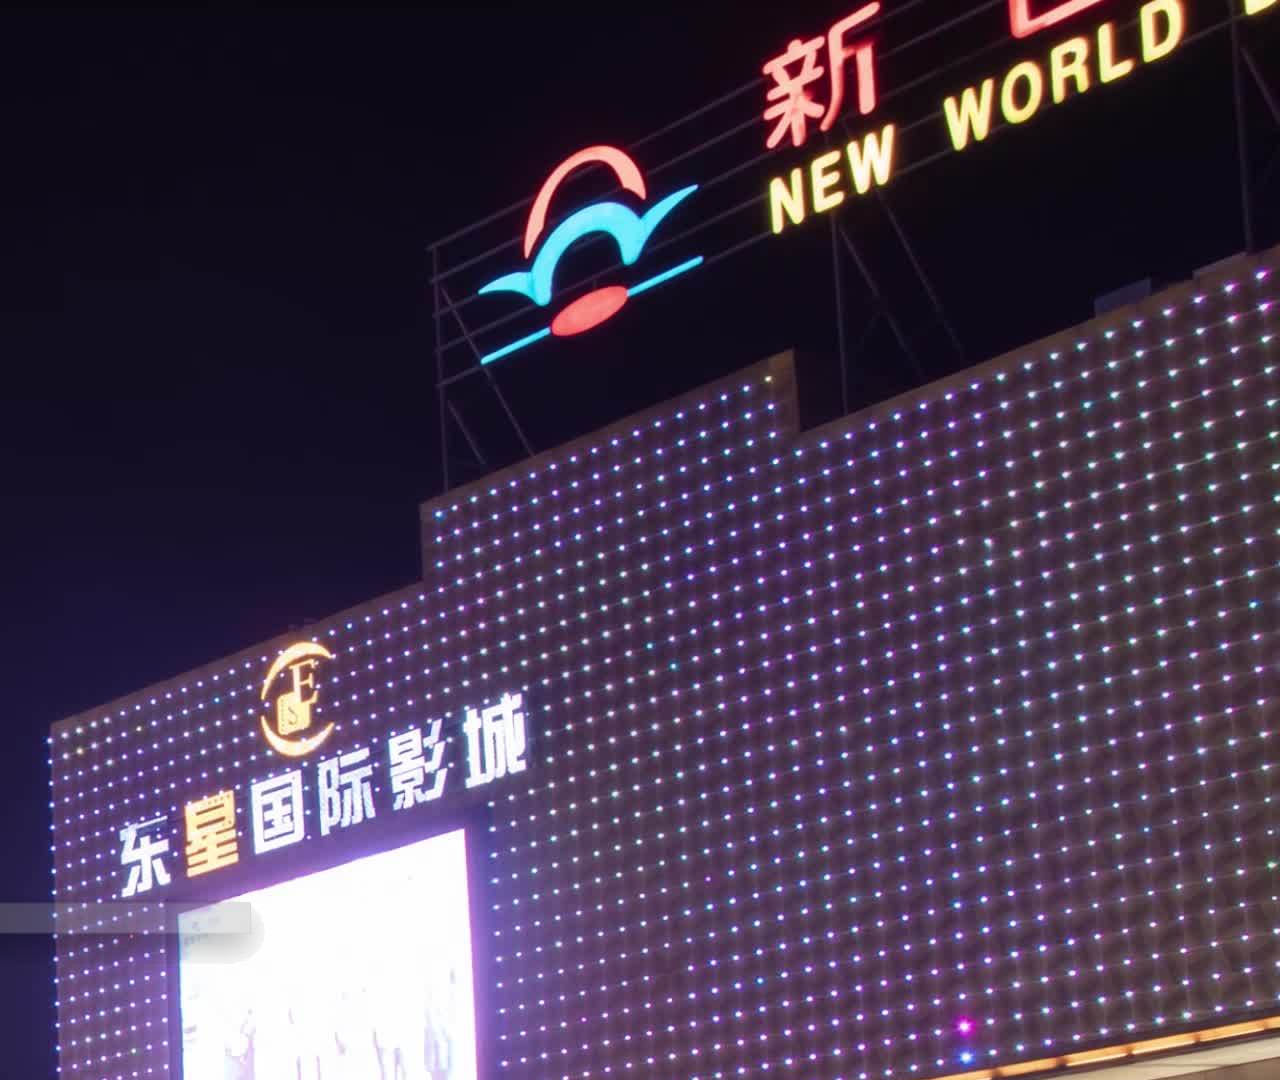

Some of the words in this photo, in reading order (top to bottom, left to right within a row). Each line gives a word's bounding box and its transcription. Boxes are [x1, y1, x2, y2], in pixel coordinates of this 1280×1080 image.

[761, 1, 881, 149] 新
[769, 126, 894, 234] NEW
[944, 0, 1185, 151] WORLD
[120, 692, 527, 898] 东星国际影城
